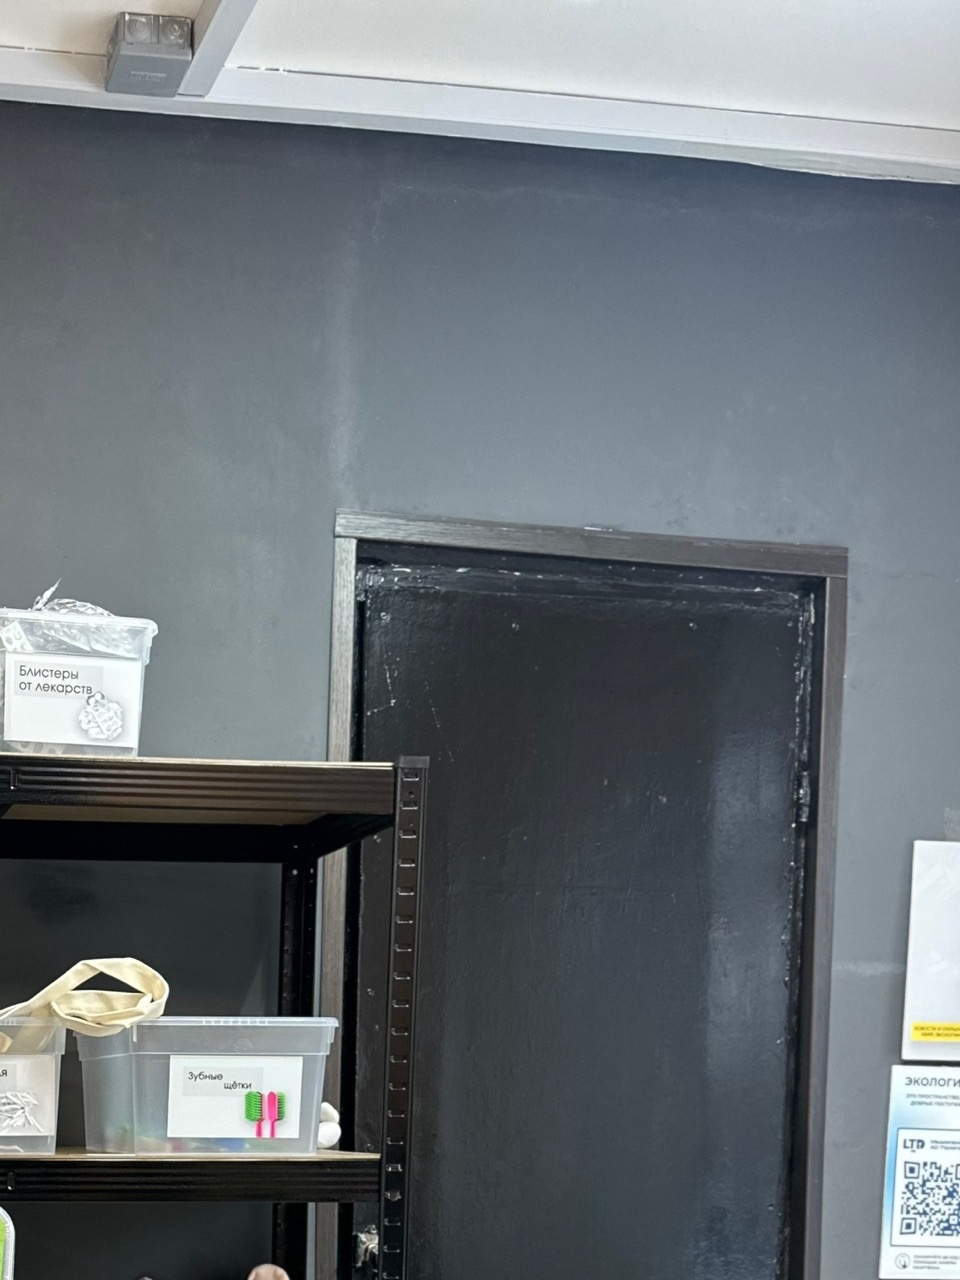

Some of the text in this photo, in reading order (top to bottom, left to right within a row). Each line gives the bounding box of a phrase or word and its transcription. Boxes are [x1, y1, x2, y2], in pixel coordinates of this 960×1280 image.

[19, 664, 79, 680] Блистеры
[19, 681, 93, 695] от лекарств
[188, 1071, 223, 1081] Зубные
[223, 1081, 252, 1090] щётки
[903, 1139, 925, 1149] LTD
